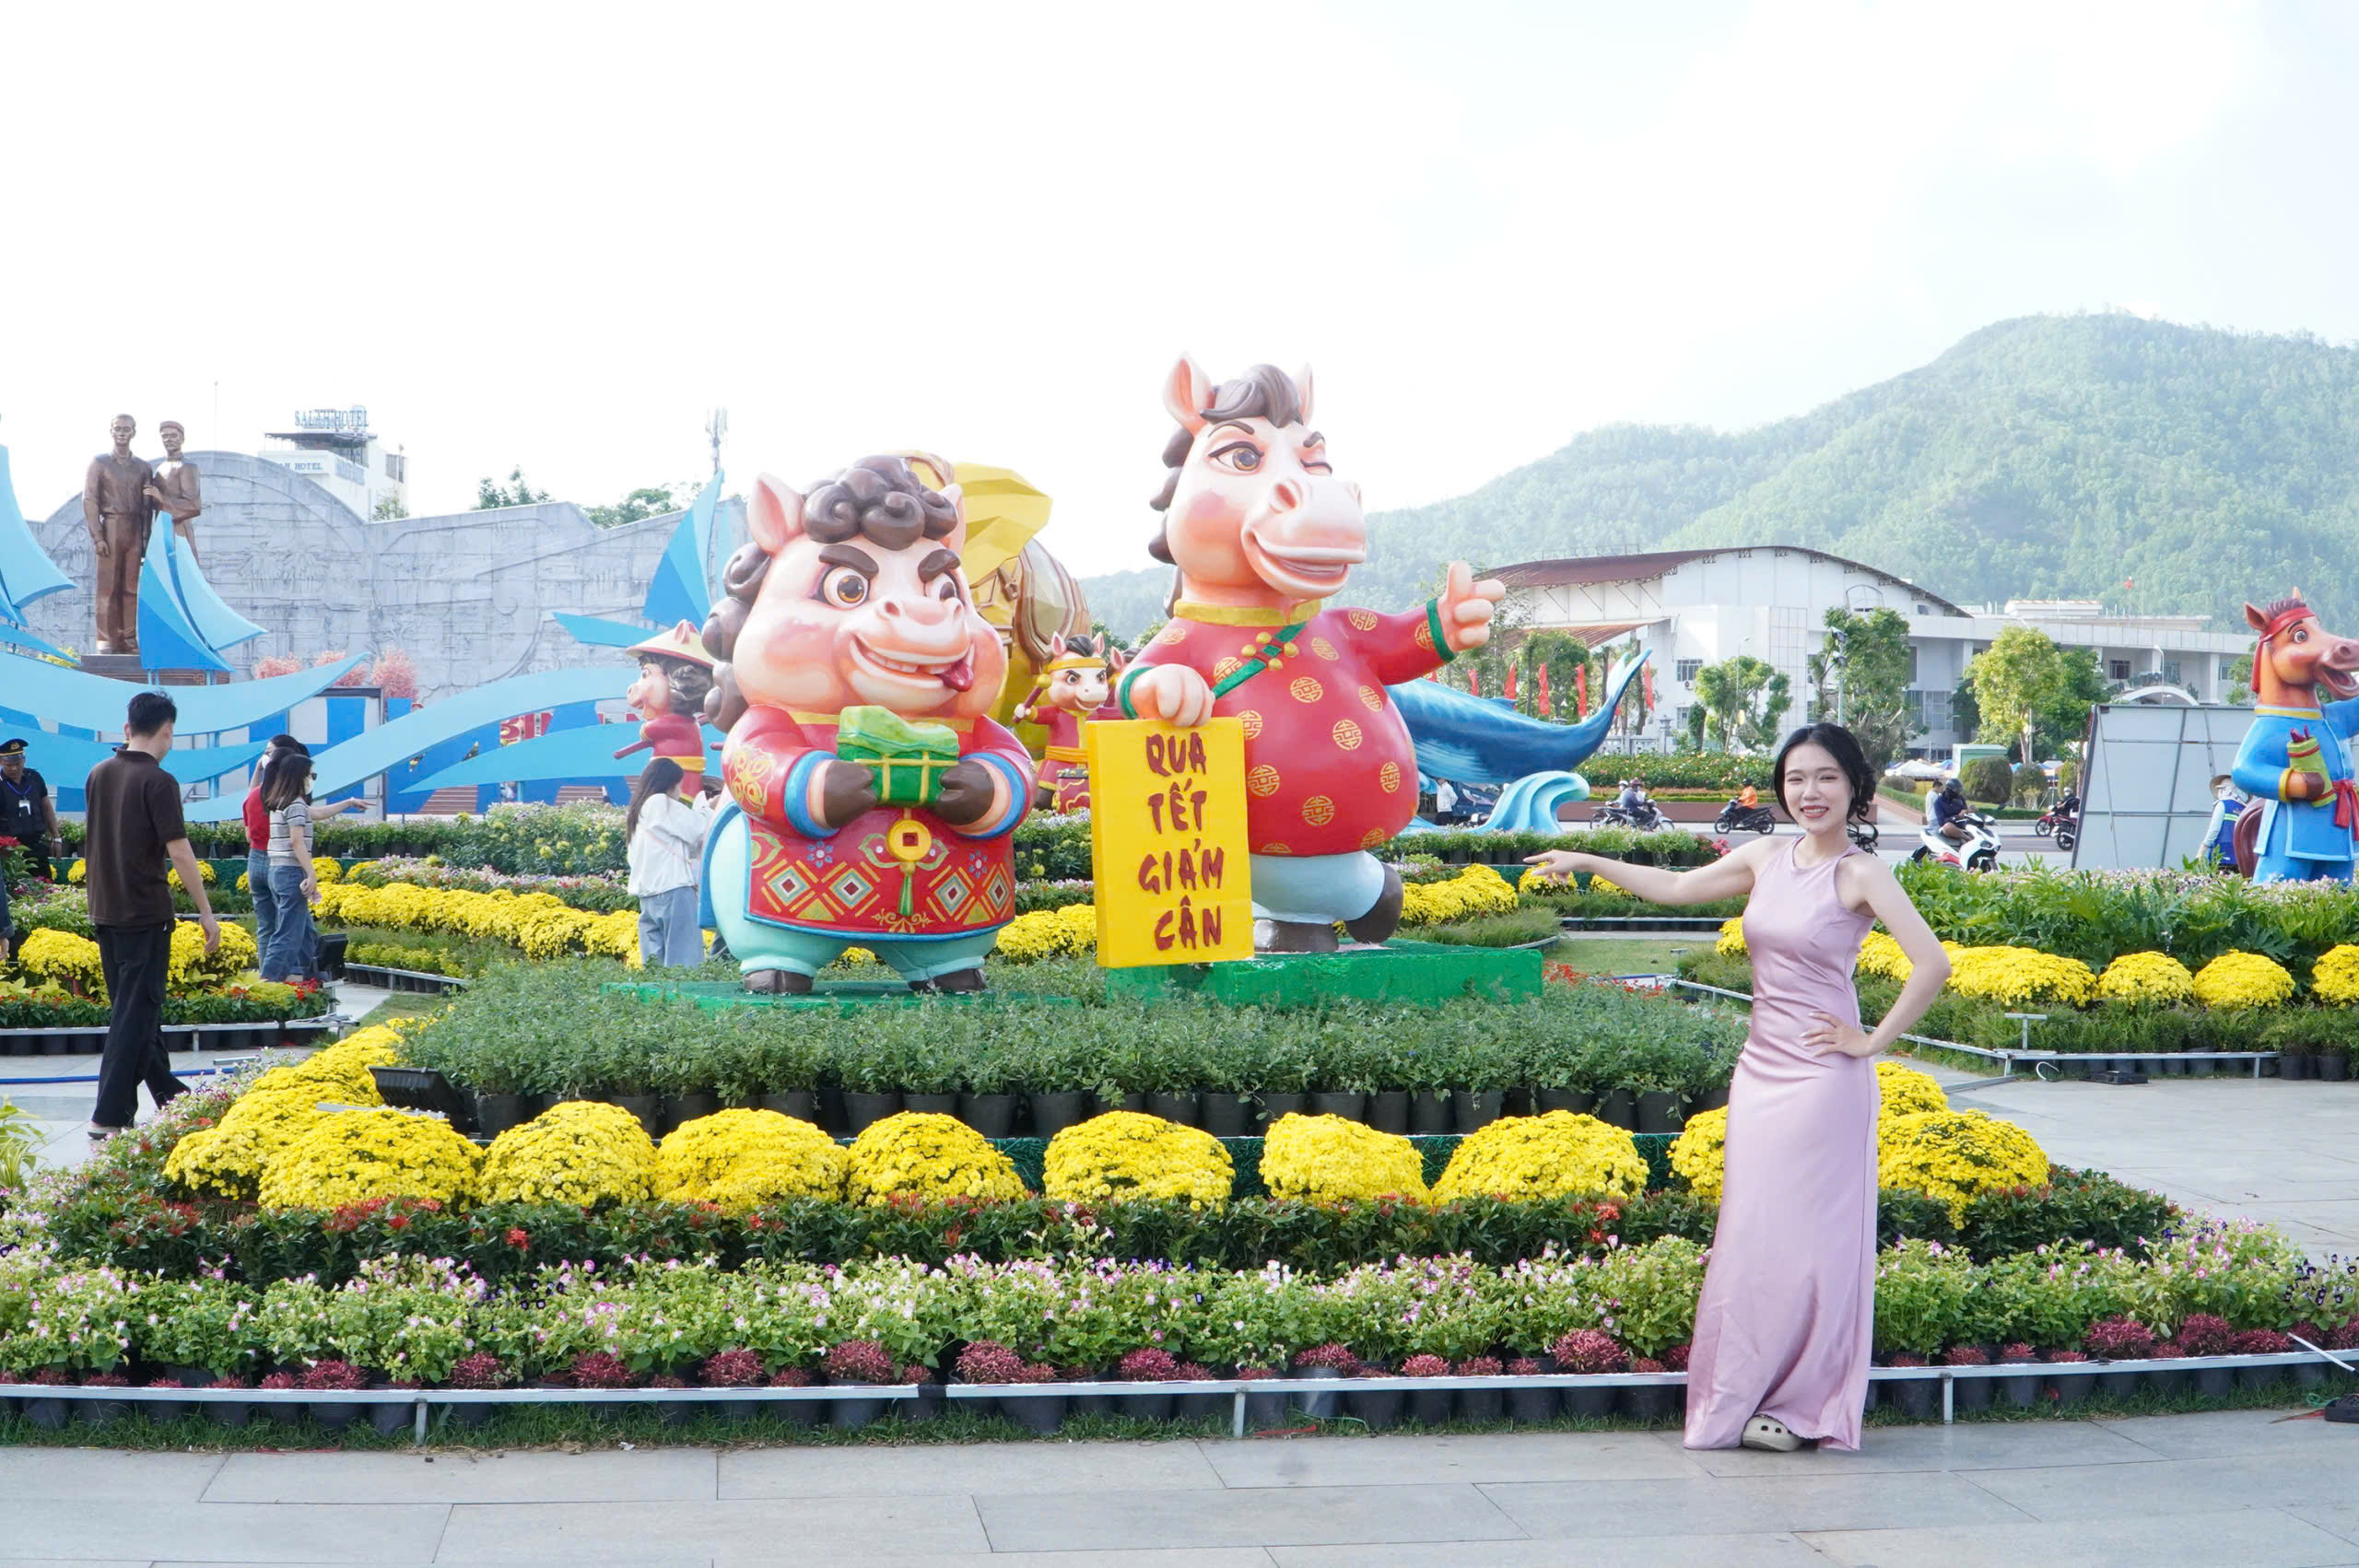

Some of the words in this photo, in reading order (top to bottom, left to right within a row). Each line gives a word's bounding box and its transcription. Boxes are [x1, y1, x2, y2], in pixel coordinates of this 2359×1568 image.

[334, 409, 370, 427] HOTEL
[294, 462, 323, 471] HOTEL
[1145, 731, 1207, 778] QUA
[1147, 778, 1207, 835] TẾT
[1138, 837, 1225, 895] GIẢM
[1154, 895, 1222, 952] CÂN
